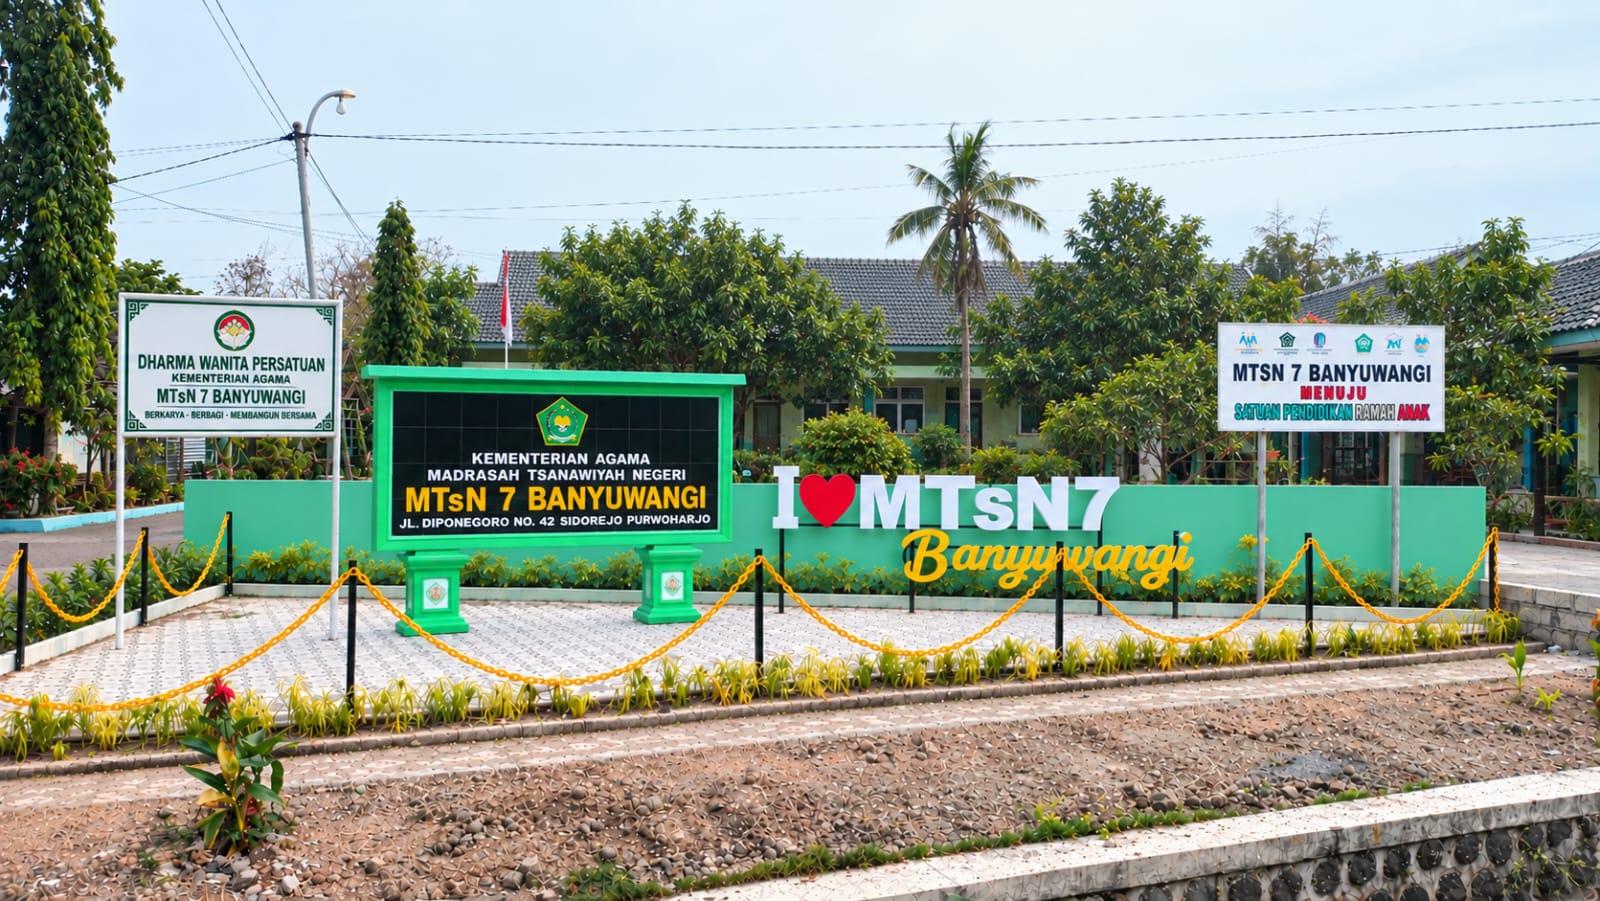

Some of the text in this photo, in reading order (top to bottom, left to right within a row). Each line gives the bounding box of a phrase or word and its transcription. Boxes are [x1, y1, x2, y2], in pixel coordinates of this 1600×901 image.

[138, 354, 325, 372] DHARMA WANITA PERSATUAN
[172, 374, 290, 384] KEMENTERIAN AGAMA
[1233, 364, 1431, 382] MTSN 7 BANYUWANGI
[157, 389, 305, 404] MTsN 7 BANYUWANGI
[1300, 386, 1367, 400] MENUJU
[145, 411, 184, 419] BERKARYA
[191, 411, 224, 419] BERBAGI
[1235, 403, 1430, 421] SATUAN PENDIDIKAN RAMAH ANAK
[472, 453, 650, 465] KEMENTERIAN AGAMA
[427, 469, 686, 482] MADRASAH TSANAWIYAH NEGERI
[405, 485, 706, 512] MTsN 7 BANYUWANGI
[772, 466, 800, 529] I
[399, 514, 710, 529] JL. DIPONEGORO NO. 42 SIDOREJO PURWOHARJO
